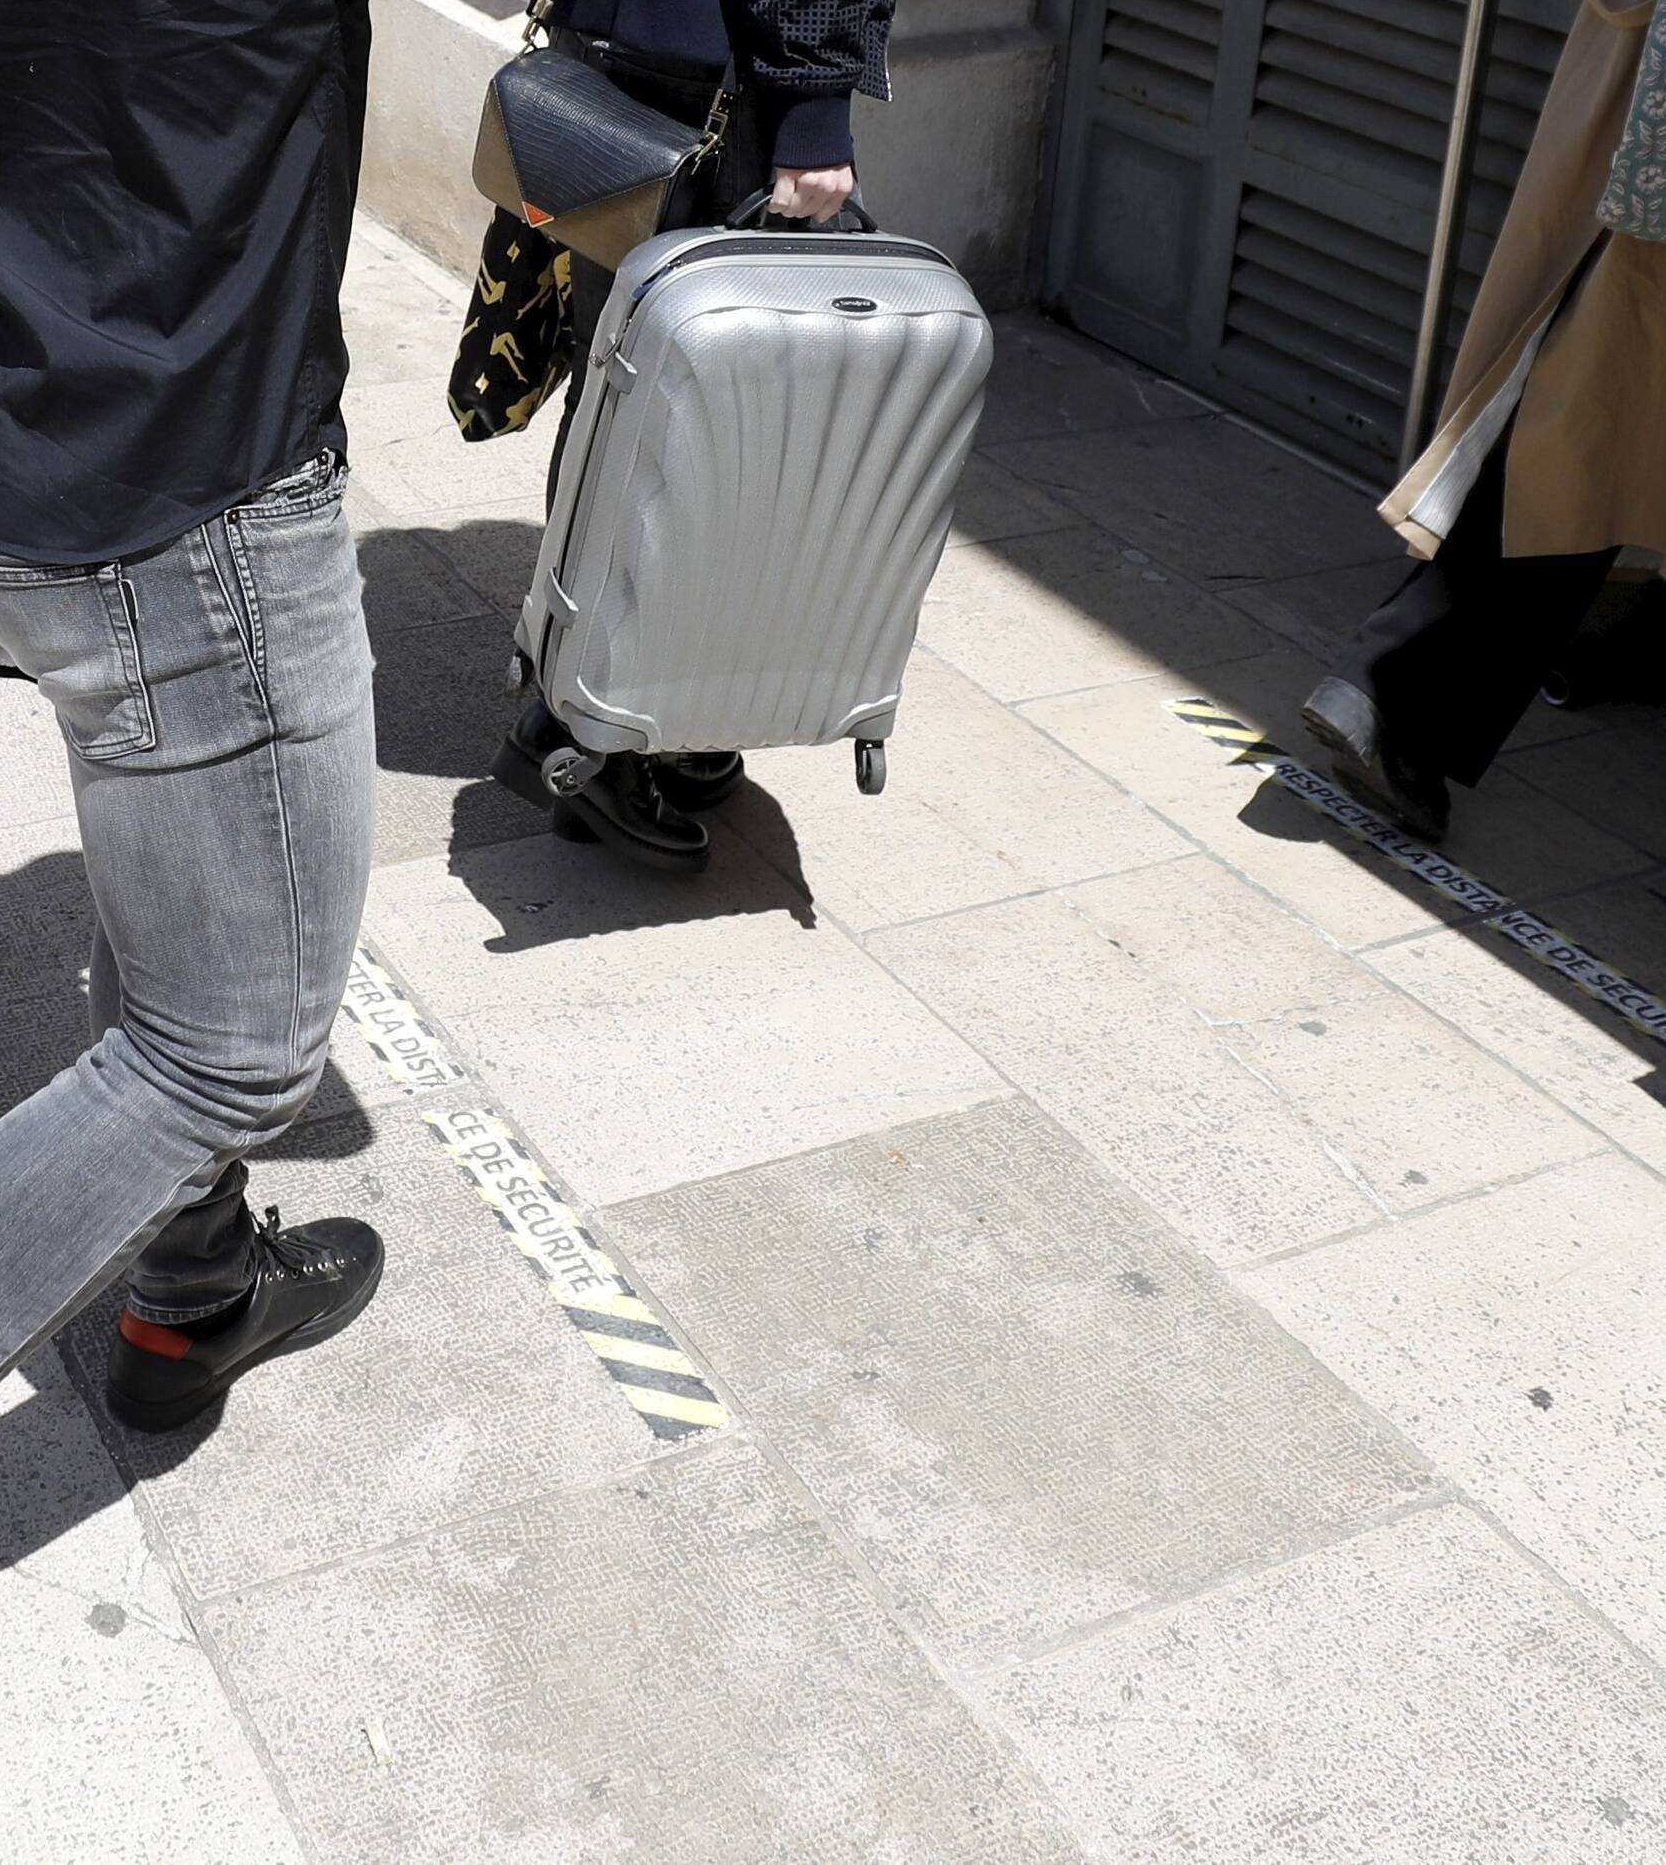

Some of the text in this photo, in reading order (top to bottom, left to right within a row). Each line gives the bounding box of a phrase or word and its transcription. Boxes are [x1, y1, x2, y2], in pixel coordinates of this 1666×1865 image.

[1277, 763, 1398, 842] RESPECTER
[1392, 843, 1430, 865] LA
[1547, 946, 1596, 974] DE
[369, 1008, 406, 1034] LA
[469, 1141, 514, 1175] DE
[495, 1176, 613, 1294] SÉCURITÉ
